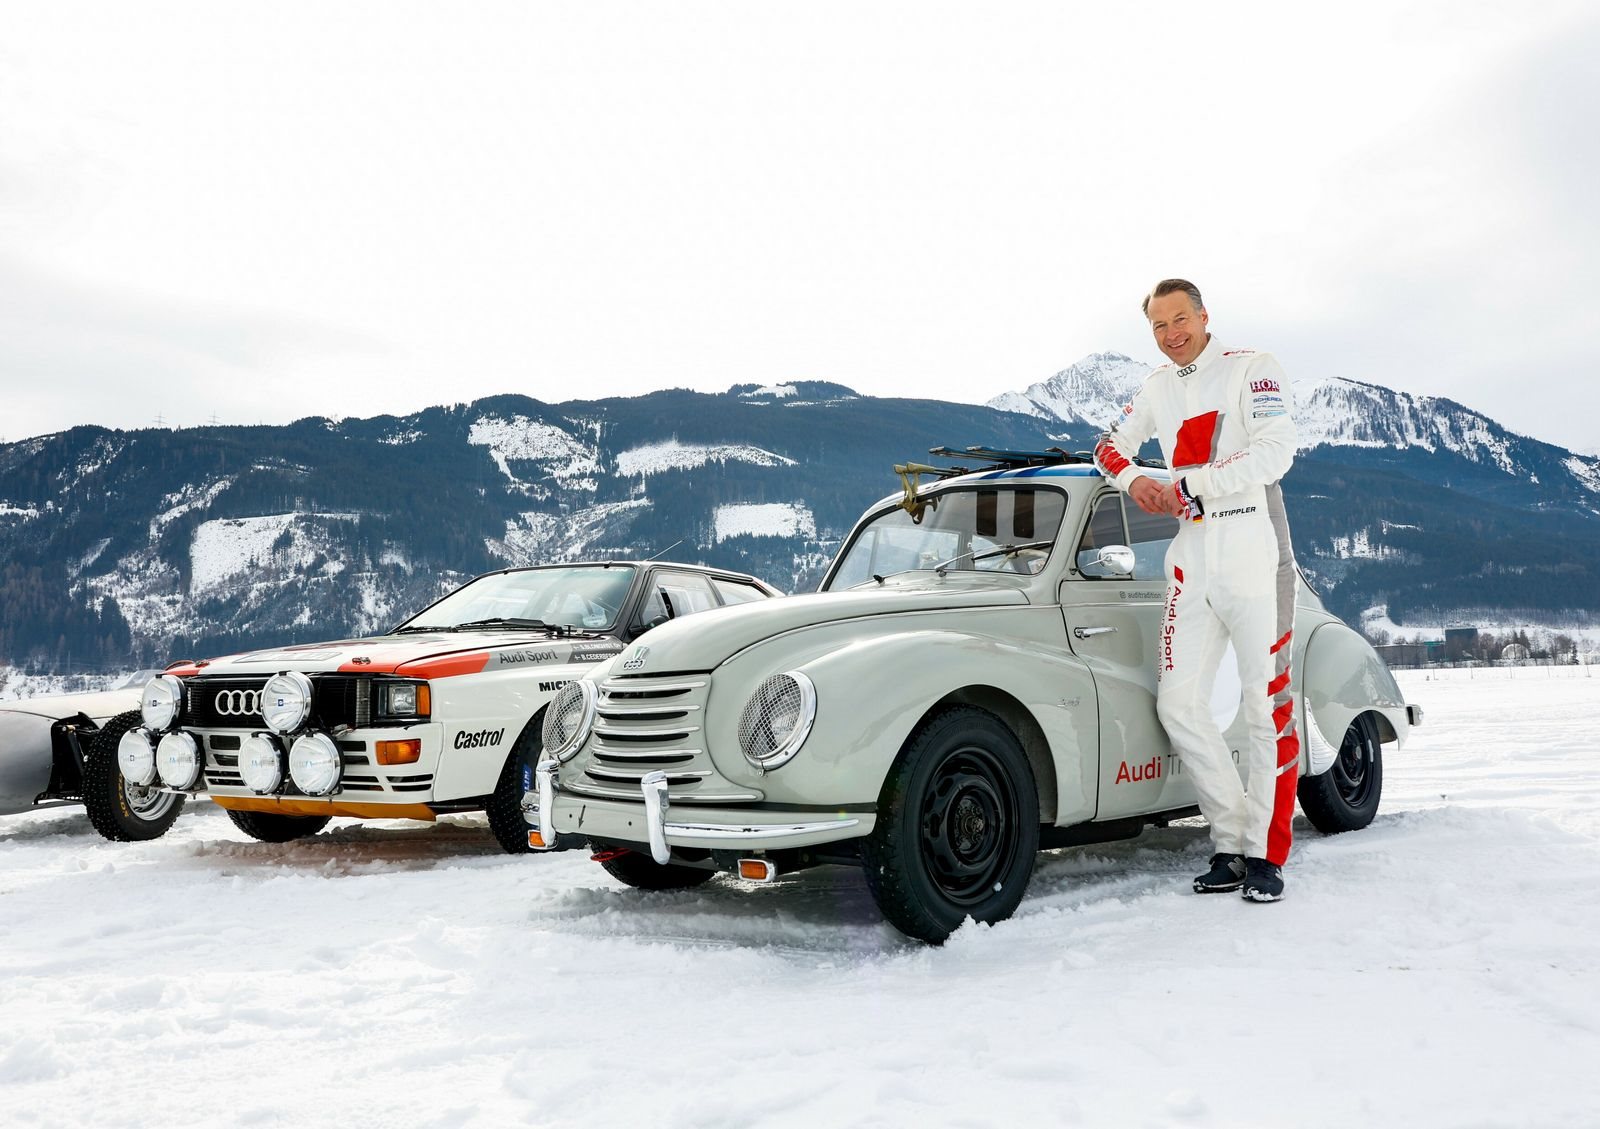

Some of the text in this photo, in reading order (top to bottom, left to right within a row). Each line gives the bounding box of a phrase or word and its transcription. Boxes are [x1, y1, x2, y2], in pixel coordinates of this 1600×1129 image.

[1218, 506, 1257, 518] STIPPLER
[1163, 585, 1182, 672] Audi Sport
[500, 649, 558, 664] Audi Sport
[454, 728, 505, 750] Castrol
[1115, 756, 1161, 785] Audi
